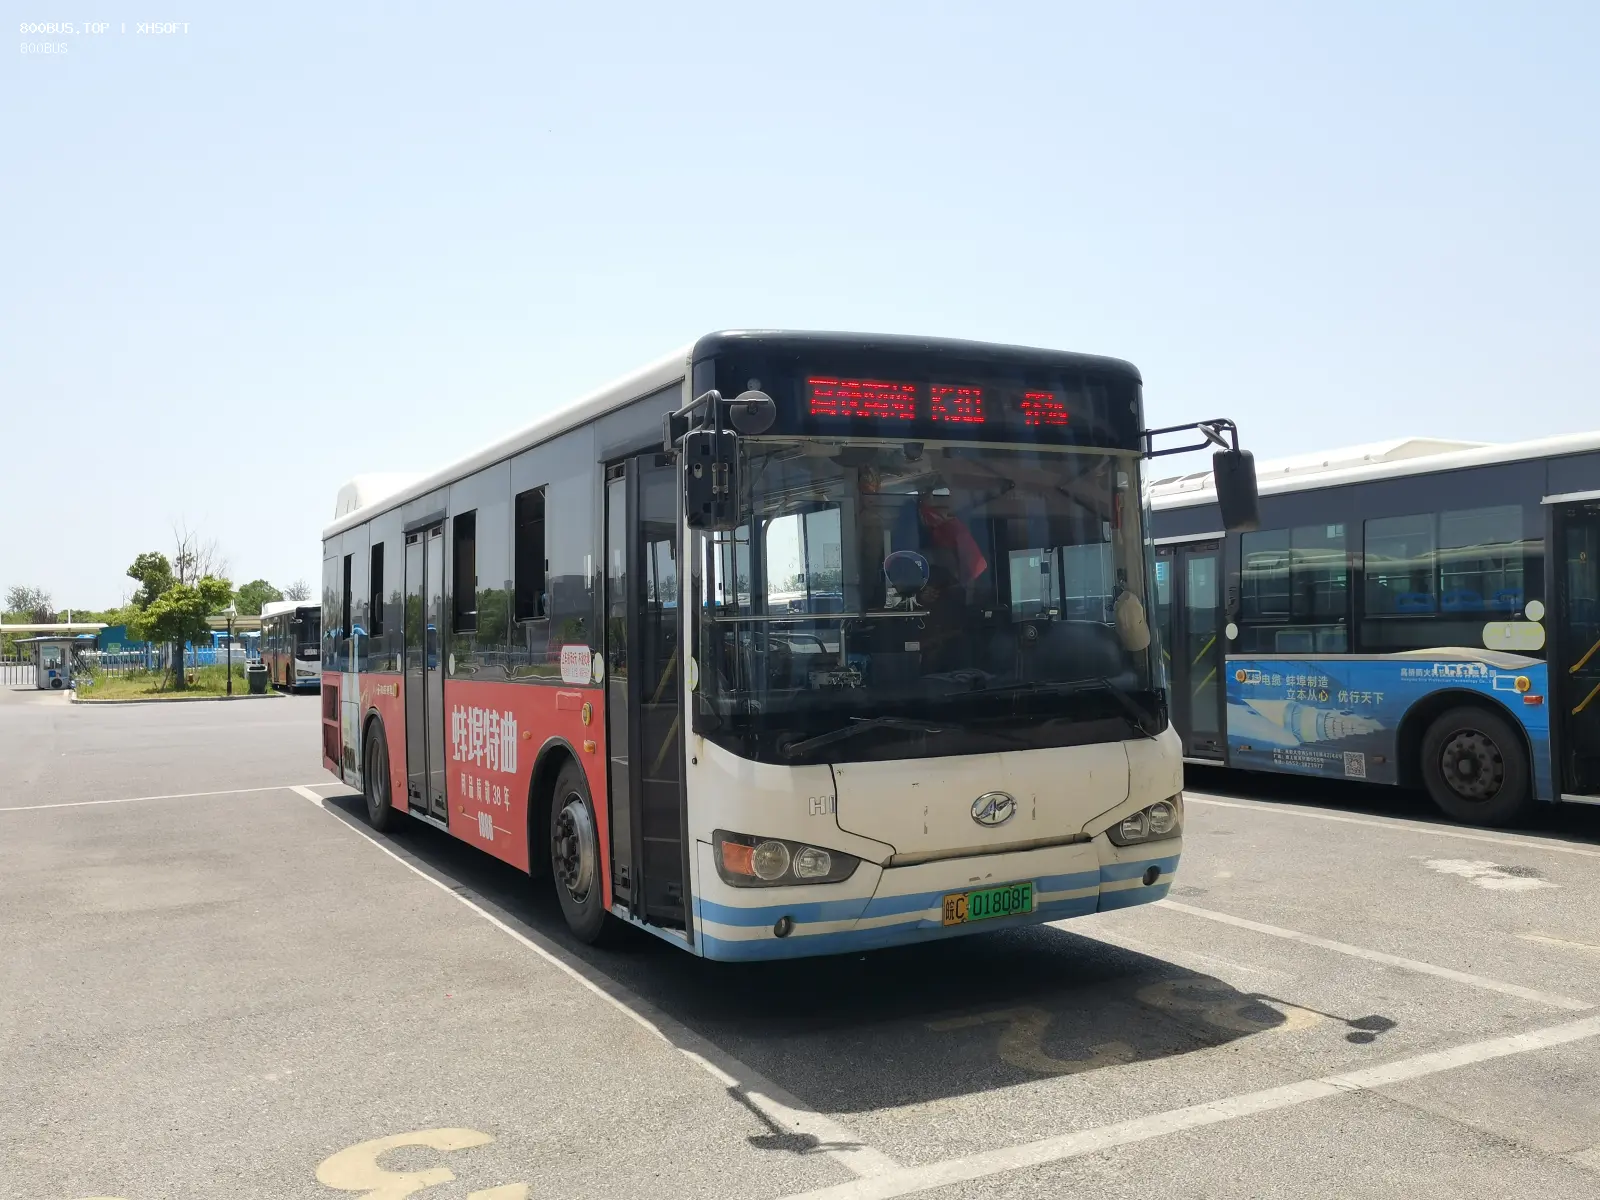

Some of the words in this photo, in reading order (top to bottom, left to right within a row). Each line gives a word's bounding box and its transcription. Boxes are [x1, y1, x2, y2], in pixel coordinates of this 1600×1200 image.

[1285, 674, 1329, 688] 蚌埠制造
[1338, 690, 1385, 705] 优行天下
[452, 704, 518, 773] 蚌埠特曲
